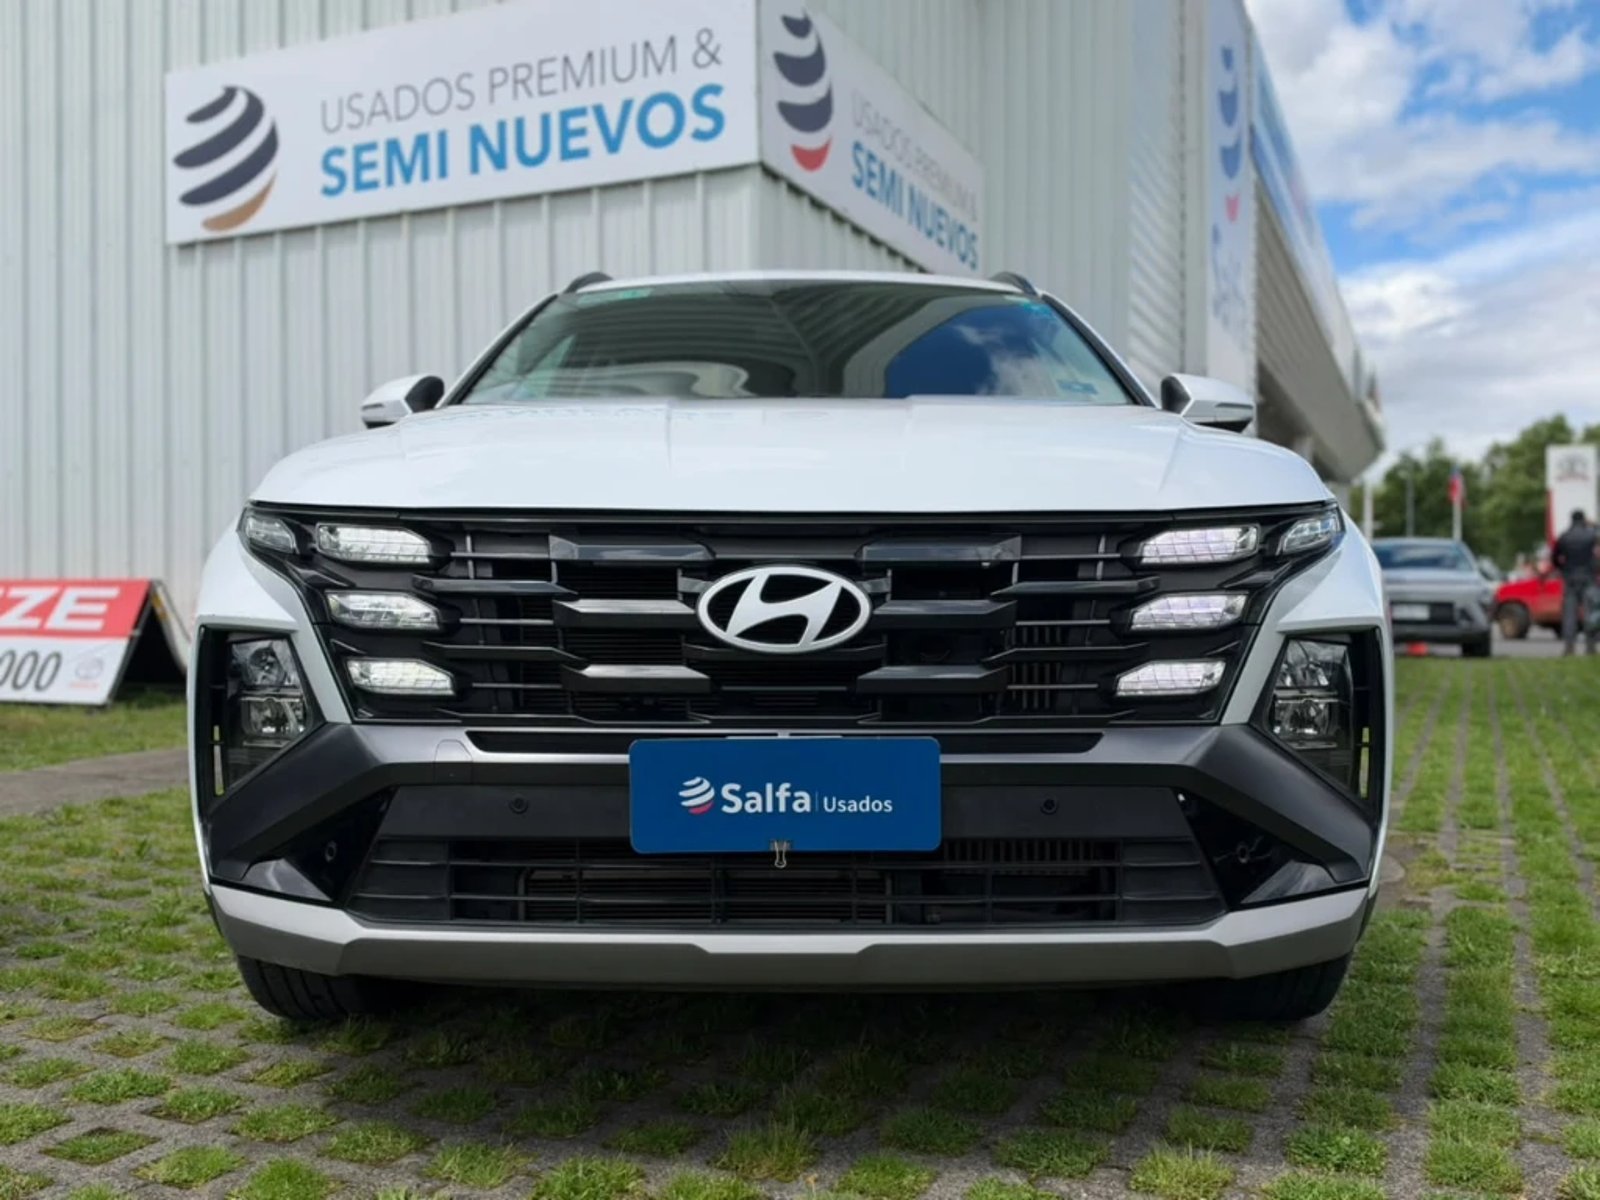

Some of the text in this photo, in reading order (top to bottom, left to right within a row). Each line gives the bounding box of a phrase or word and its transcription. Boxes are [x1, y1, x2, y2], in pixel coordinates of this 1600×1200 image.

[319, 27, 723, 134] USADOS PREMIUM &
[319, 83, 726, 198] SEMI NUEVOS
[850, 140, 979, 272] SEMI NUEVOS
[0, 586, 120, 632] ZE
[720, 782, 894, 814] Salfa Usados
